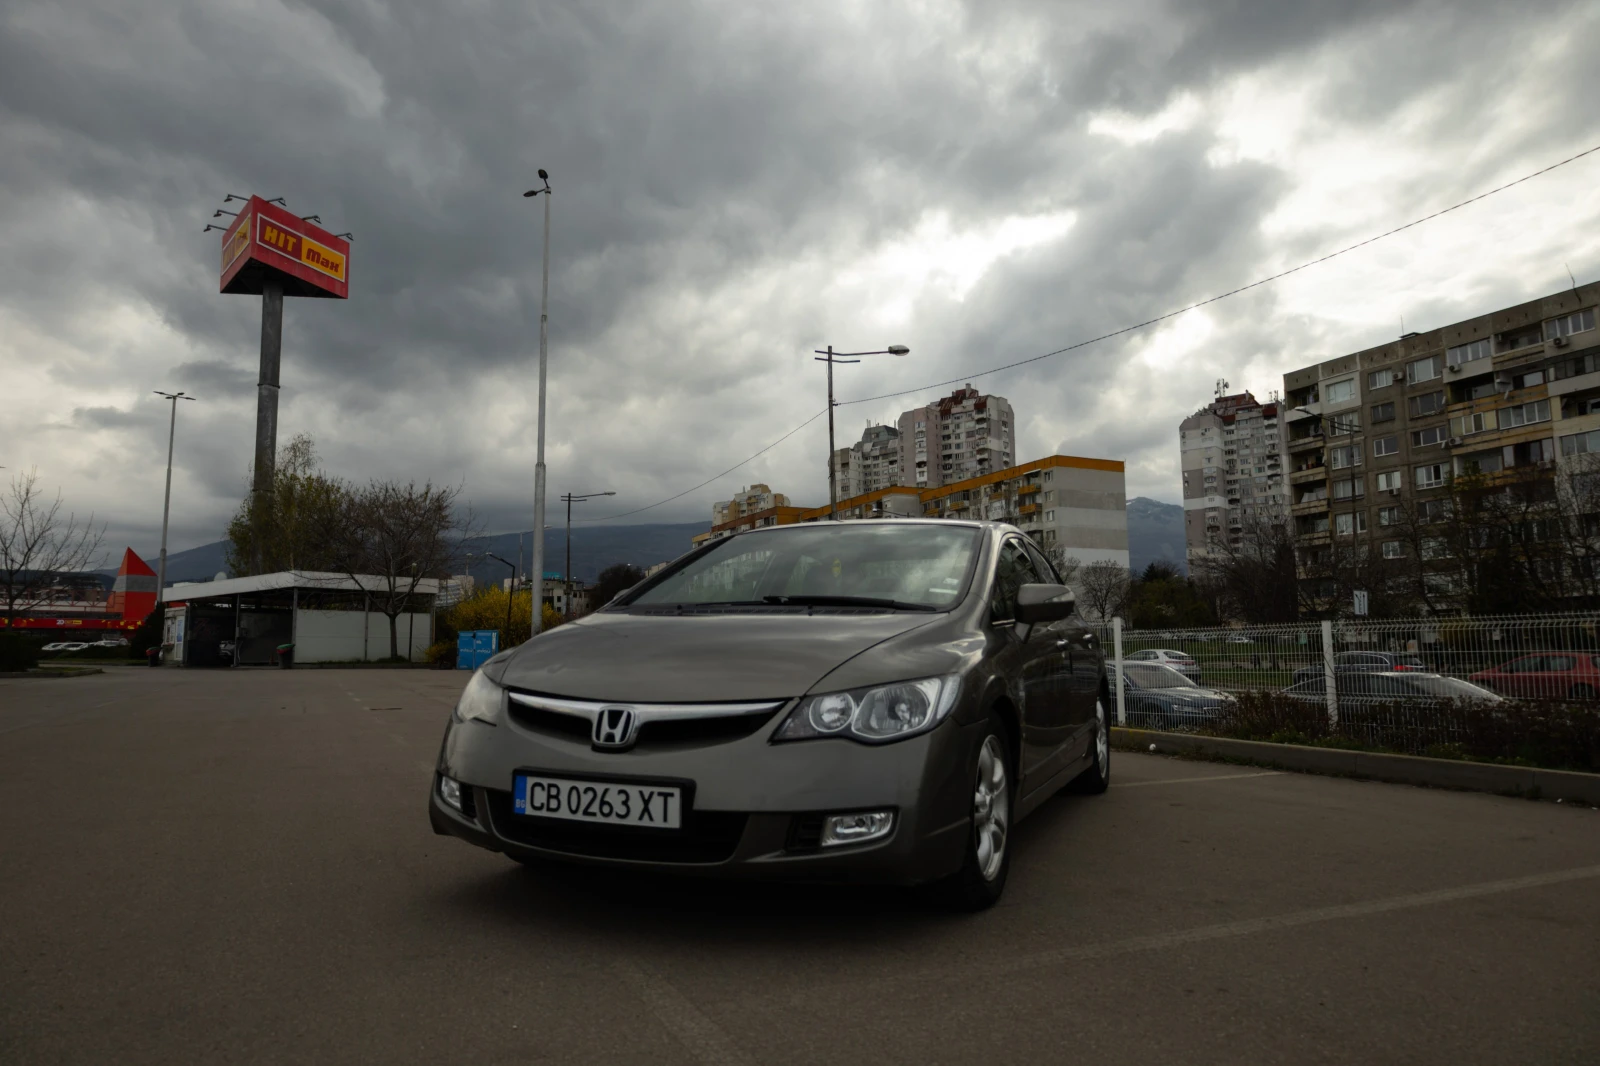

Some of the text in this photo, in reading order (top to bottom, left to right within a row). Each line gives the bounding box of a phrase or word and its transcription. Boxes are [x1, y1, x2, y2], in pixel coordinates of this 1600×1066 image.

[263, 225, 297, 252] HIT
[515, 799, 526, 809] BG
[530, 781, 675, 823] CB 0263 XT
